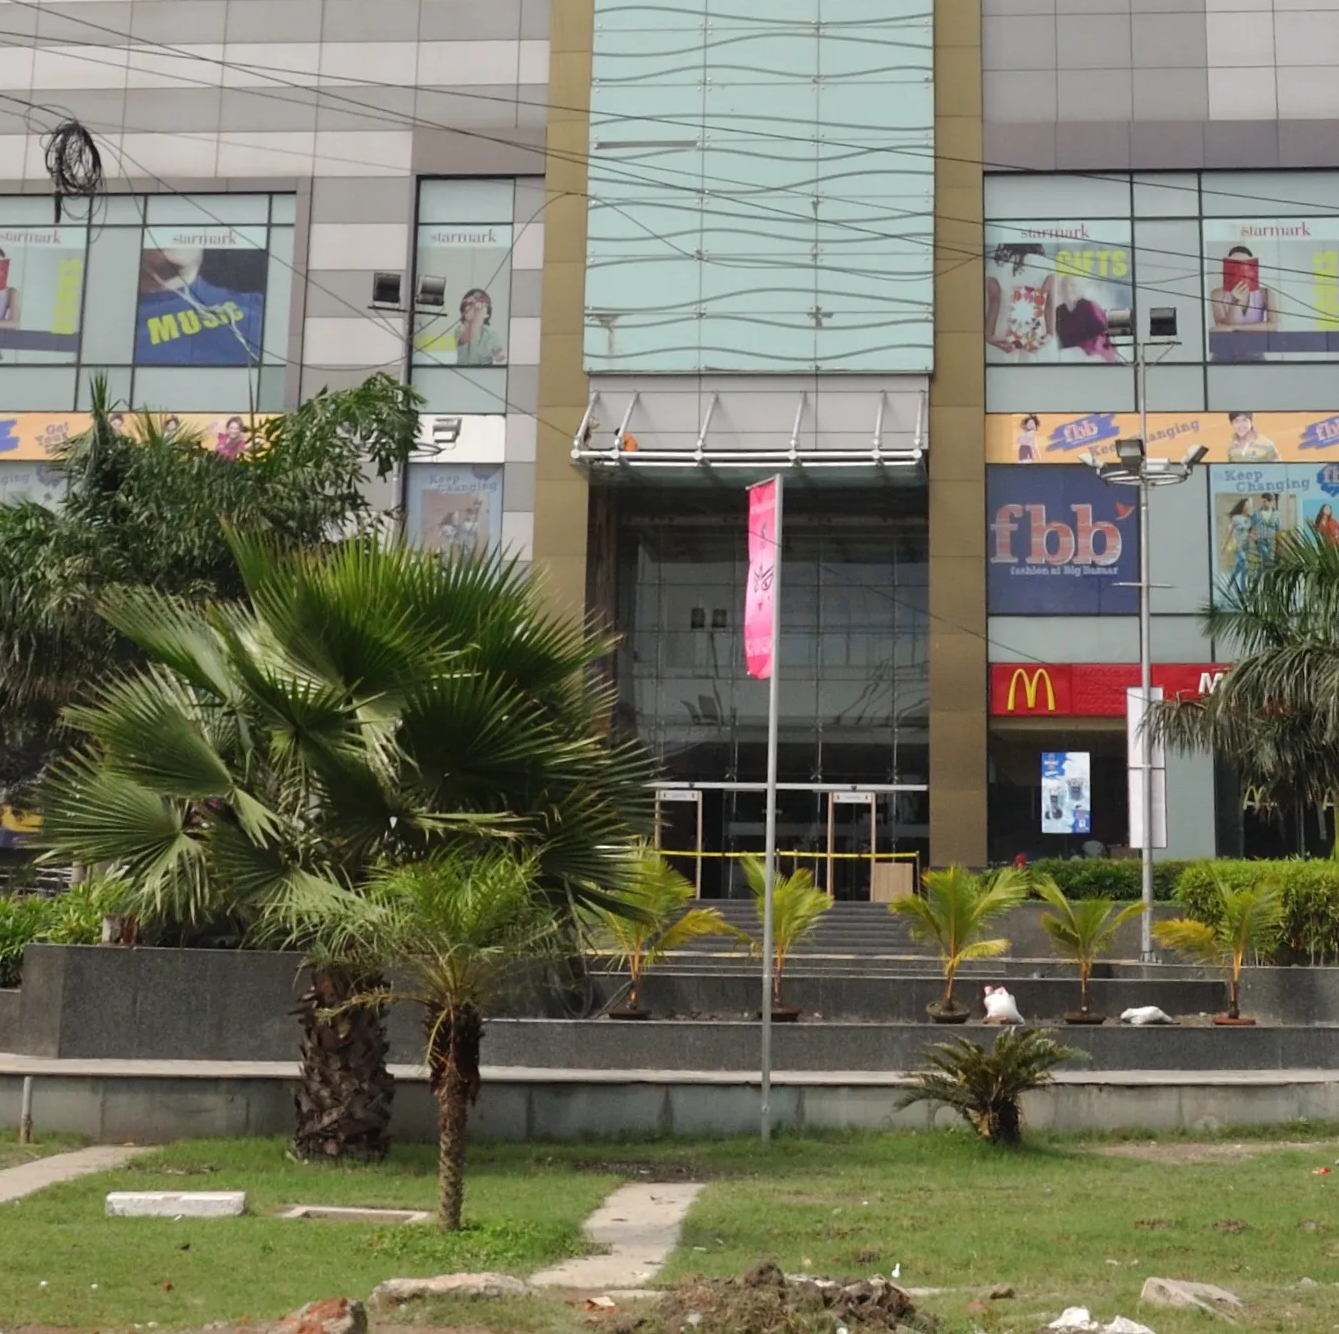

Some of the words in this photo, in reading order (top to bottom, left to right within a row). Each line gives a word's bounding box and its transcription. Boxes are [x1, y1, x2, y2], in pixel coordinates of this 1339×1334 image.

[173, 229, 238, 245] starmark
[431, 228, 497, 244] starmark
[1021, 223, 1091, 239] starmark
[1241, 221, 1312, 237] starmark
[1056, 249, 1128, 278] GIFTS
[1064, 420, 1098, 442] fbb
[1224, 470, 1263, 483] Keep
[1236, 478, 1310, 493] Changing
[990, 503, 1123, 566] fbb
